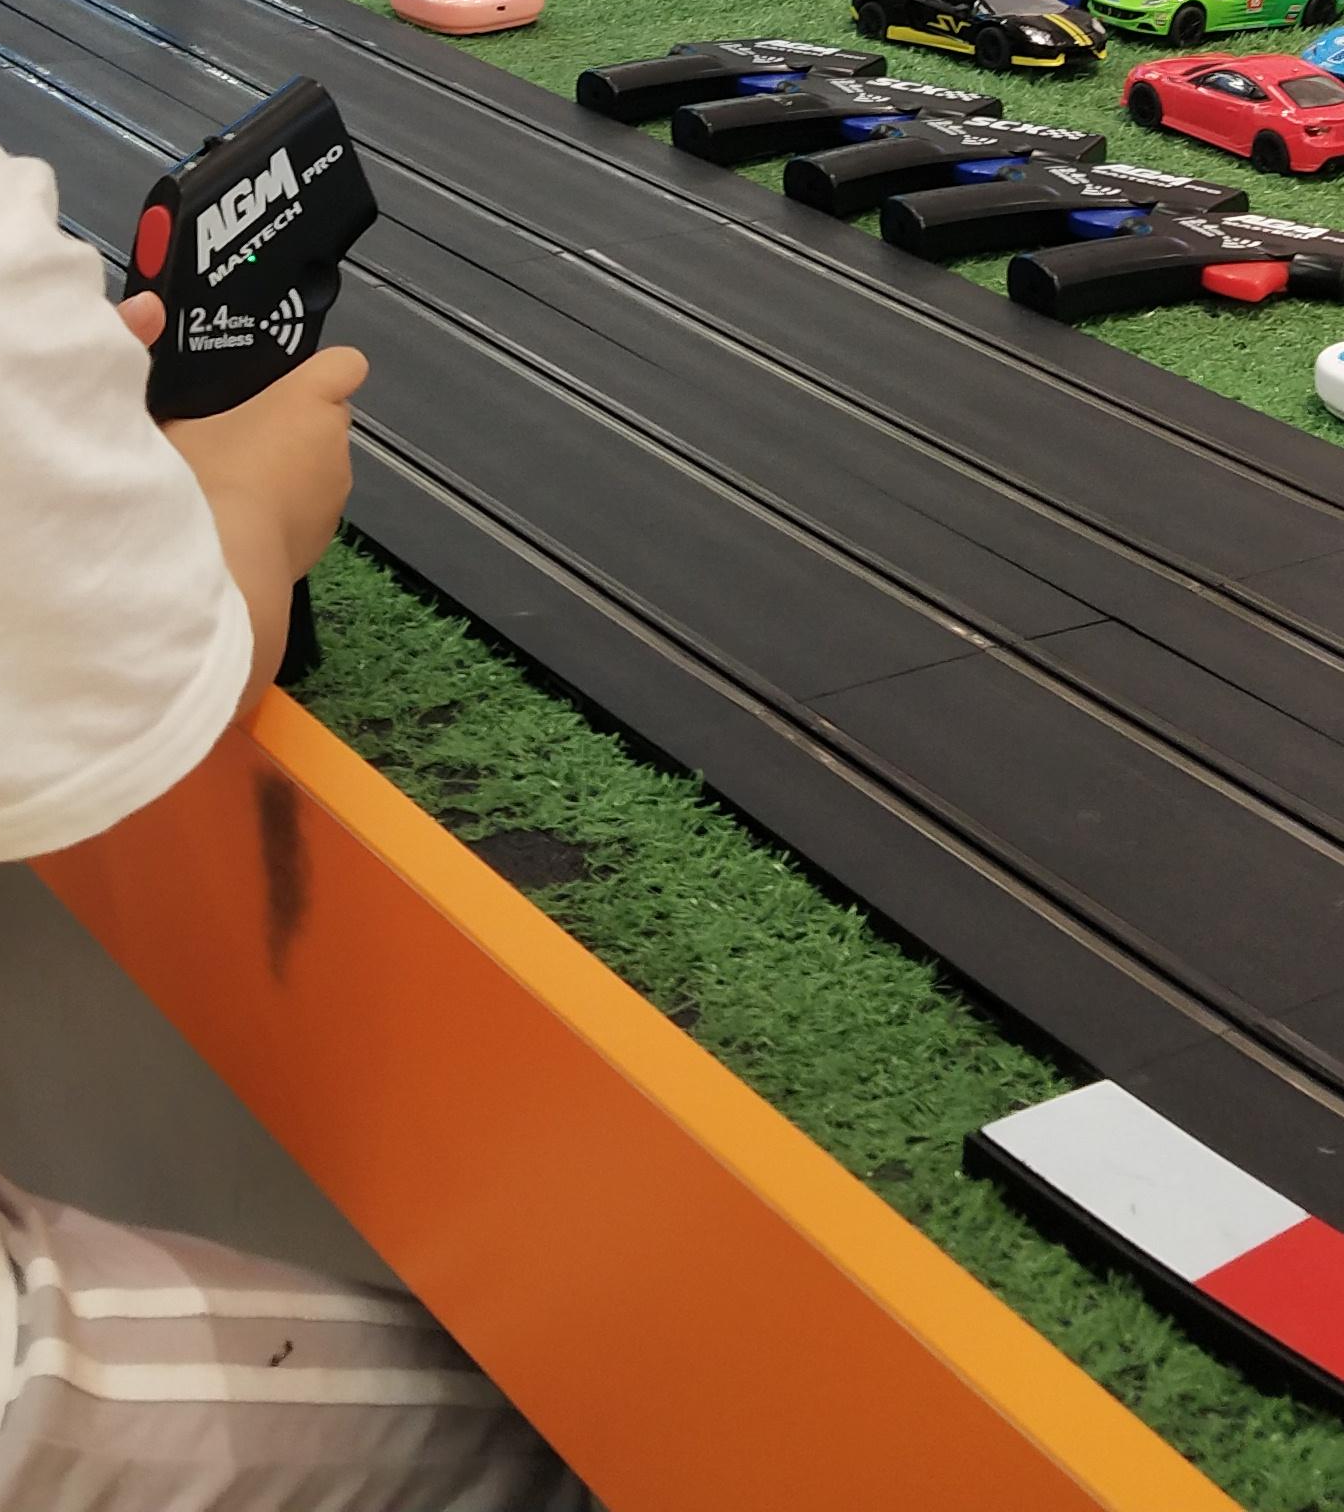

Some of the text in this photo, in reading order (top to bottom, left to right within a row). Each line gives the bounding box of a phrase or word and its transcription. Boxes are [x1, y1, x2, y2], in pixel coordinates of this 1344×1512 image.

[302, 144, 345, 185] PRO
[196, 147, 301, 275] AGM
[208, 202, 304, 288] MASTECH
[188, 305, 255, 334] 2.4GHz
[188, 331, 255, 353] Wireless
